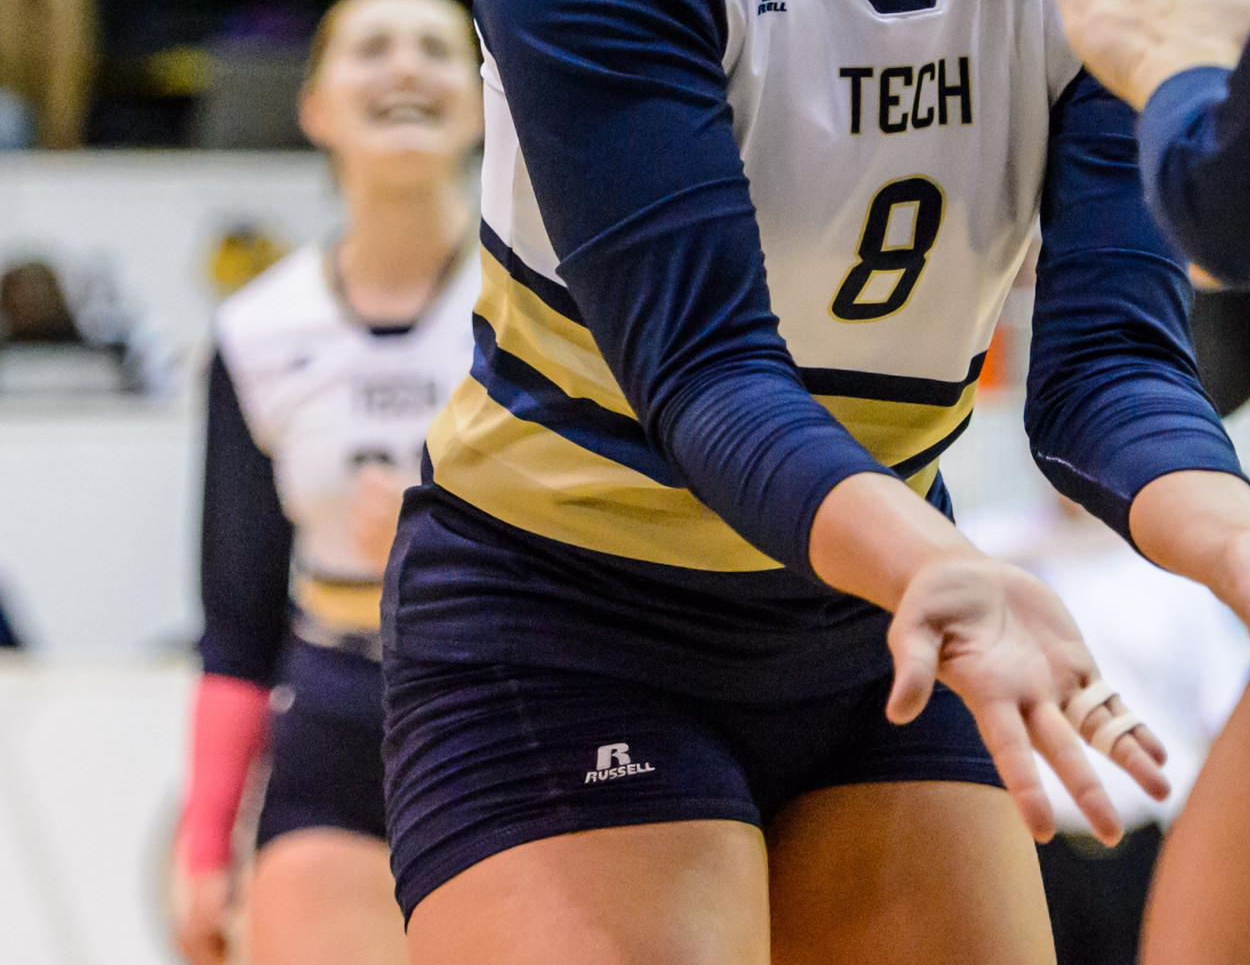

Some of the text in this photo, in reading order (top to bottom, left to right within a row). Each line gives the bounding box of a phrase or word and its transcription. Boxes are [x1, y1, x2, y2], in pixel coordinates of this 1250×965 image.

[839, 56, 973, 135] TECH
[828, 174, 947, 324] 8
[584, 762, 656, 784] RUSSELL
[596, 742, 631, 771] R
